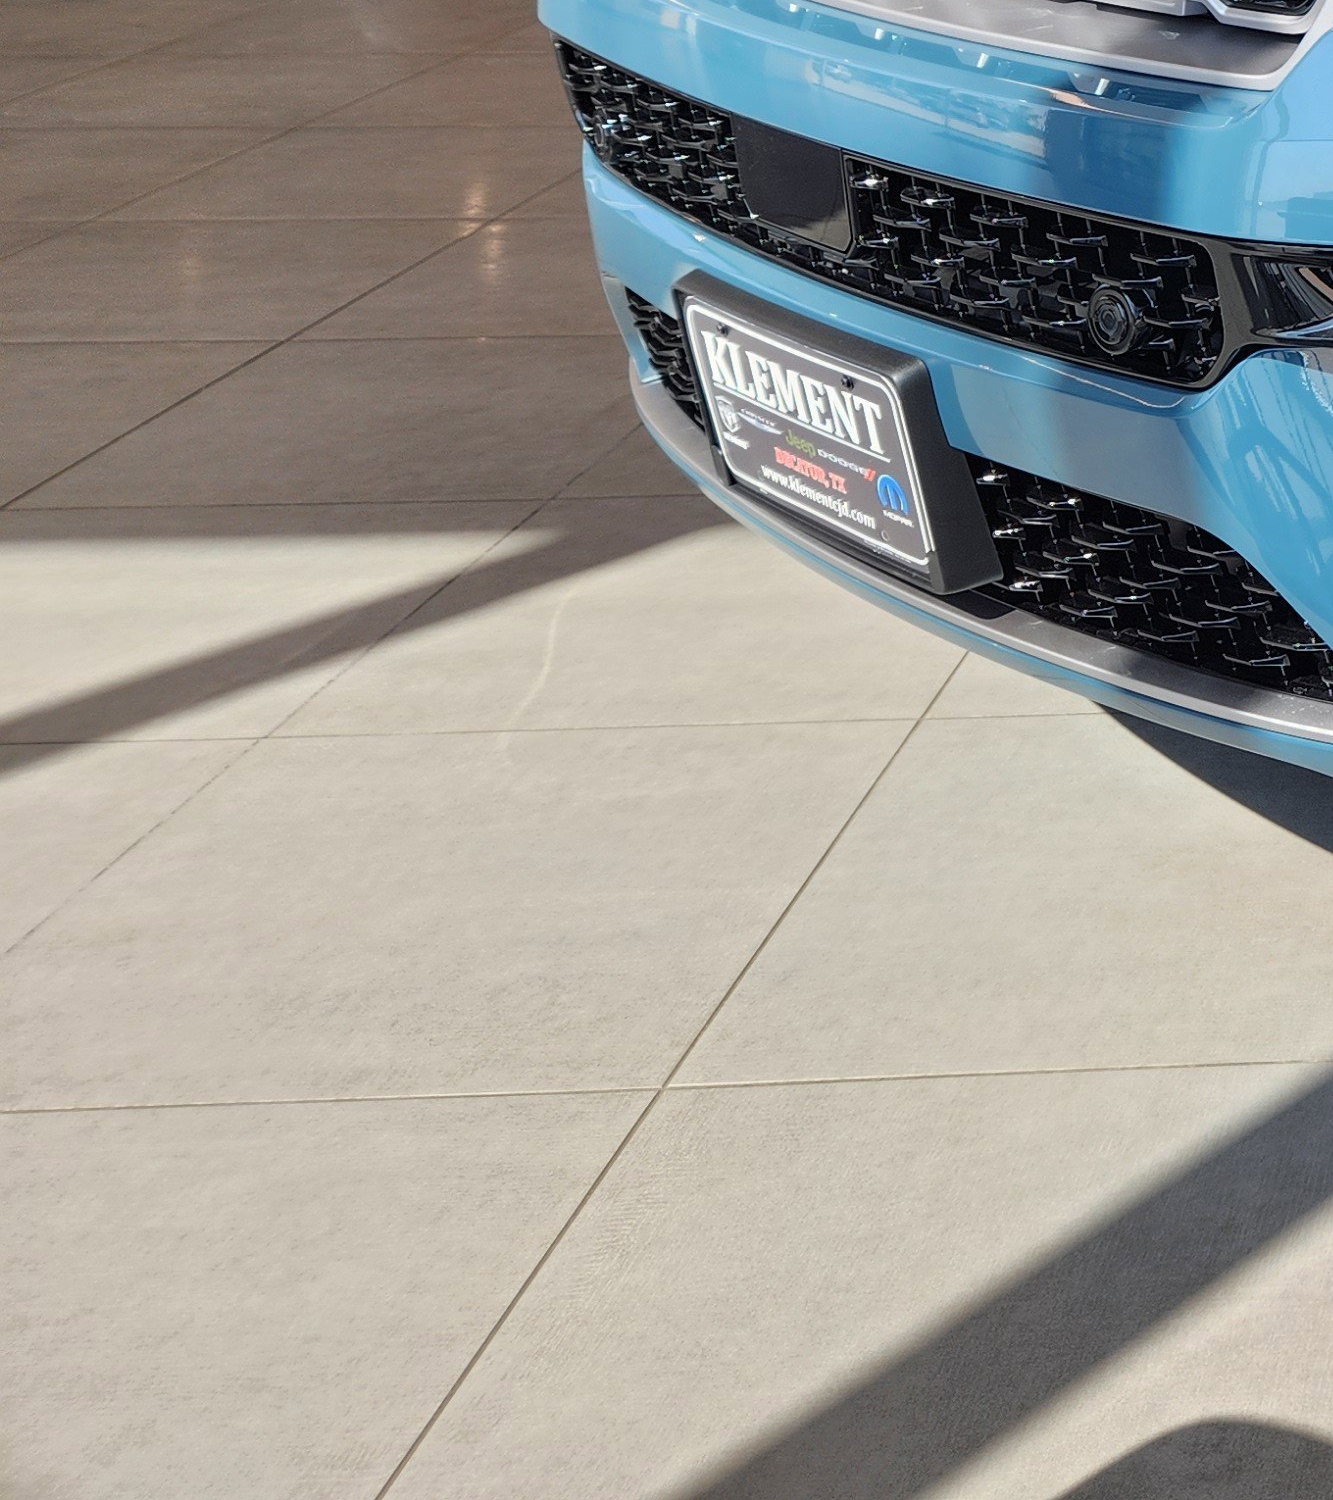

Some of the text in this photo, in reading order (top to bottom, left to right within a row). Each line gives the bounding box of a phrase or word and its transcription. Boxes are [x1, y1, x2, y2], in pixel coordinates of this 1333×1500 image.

[701, 330, 888, 455] KLEMENT
[785, 428, 817, 458] Jeep
[761, 465, 876, 529] www.klementcjd.com
[829, 472, 848, 495] TX
